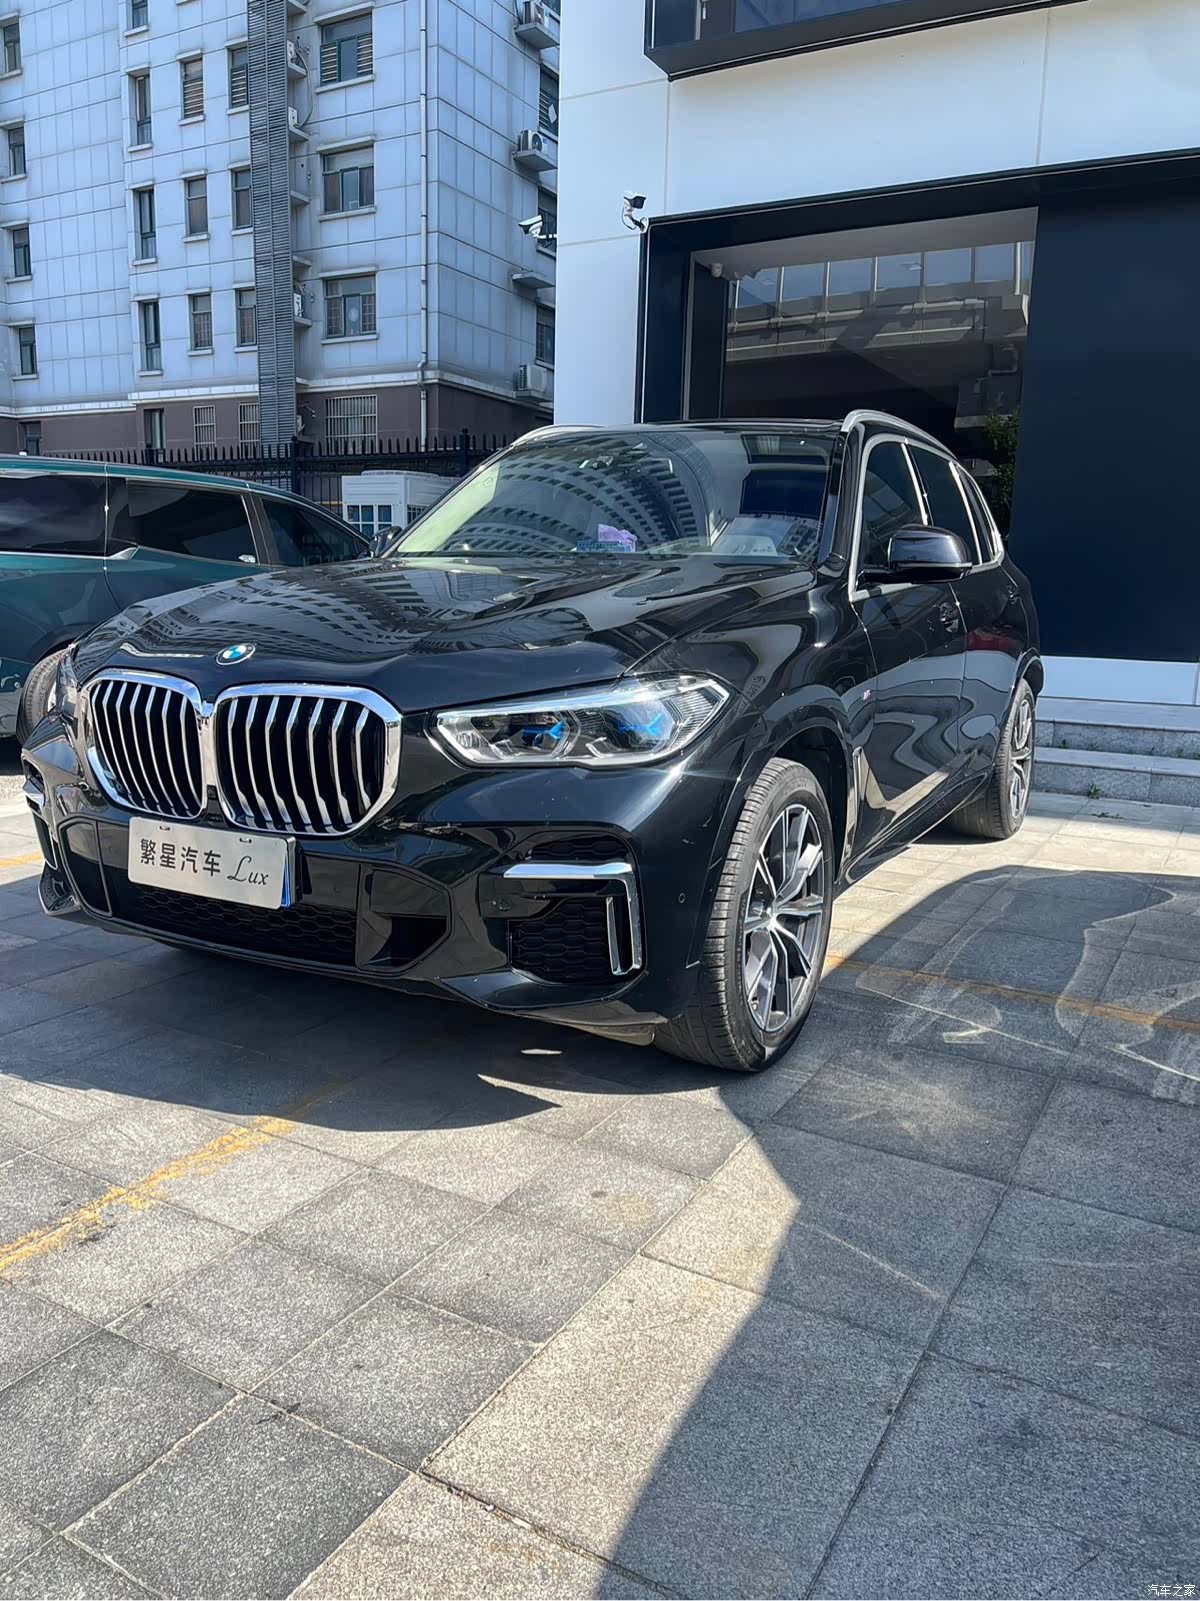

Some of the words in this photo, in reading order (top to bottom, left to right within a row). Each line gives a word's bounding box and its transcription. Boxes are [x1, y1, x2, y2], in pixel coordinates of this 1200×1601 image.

[140, 838, 222, 877] 繁星汽车
[227, 855, 269, 886] Lux
